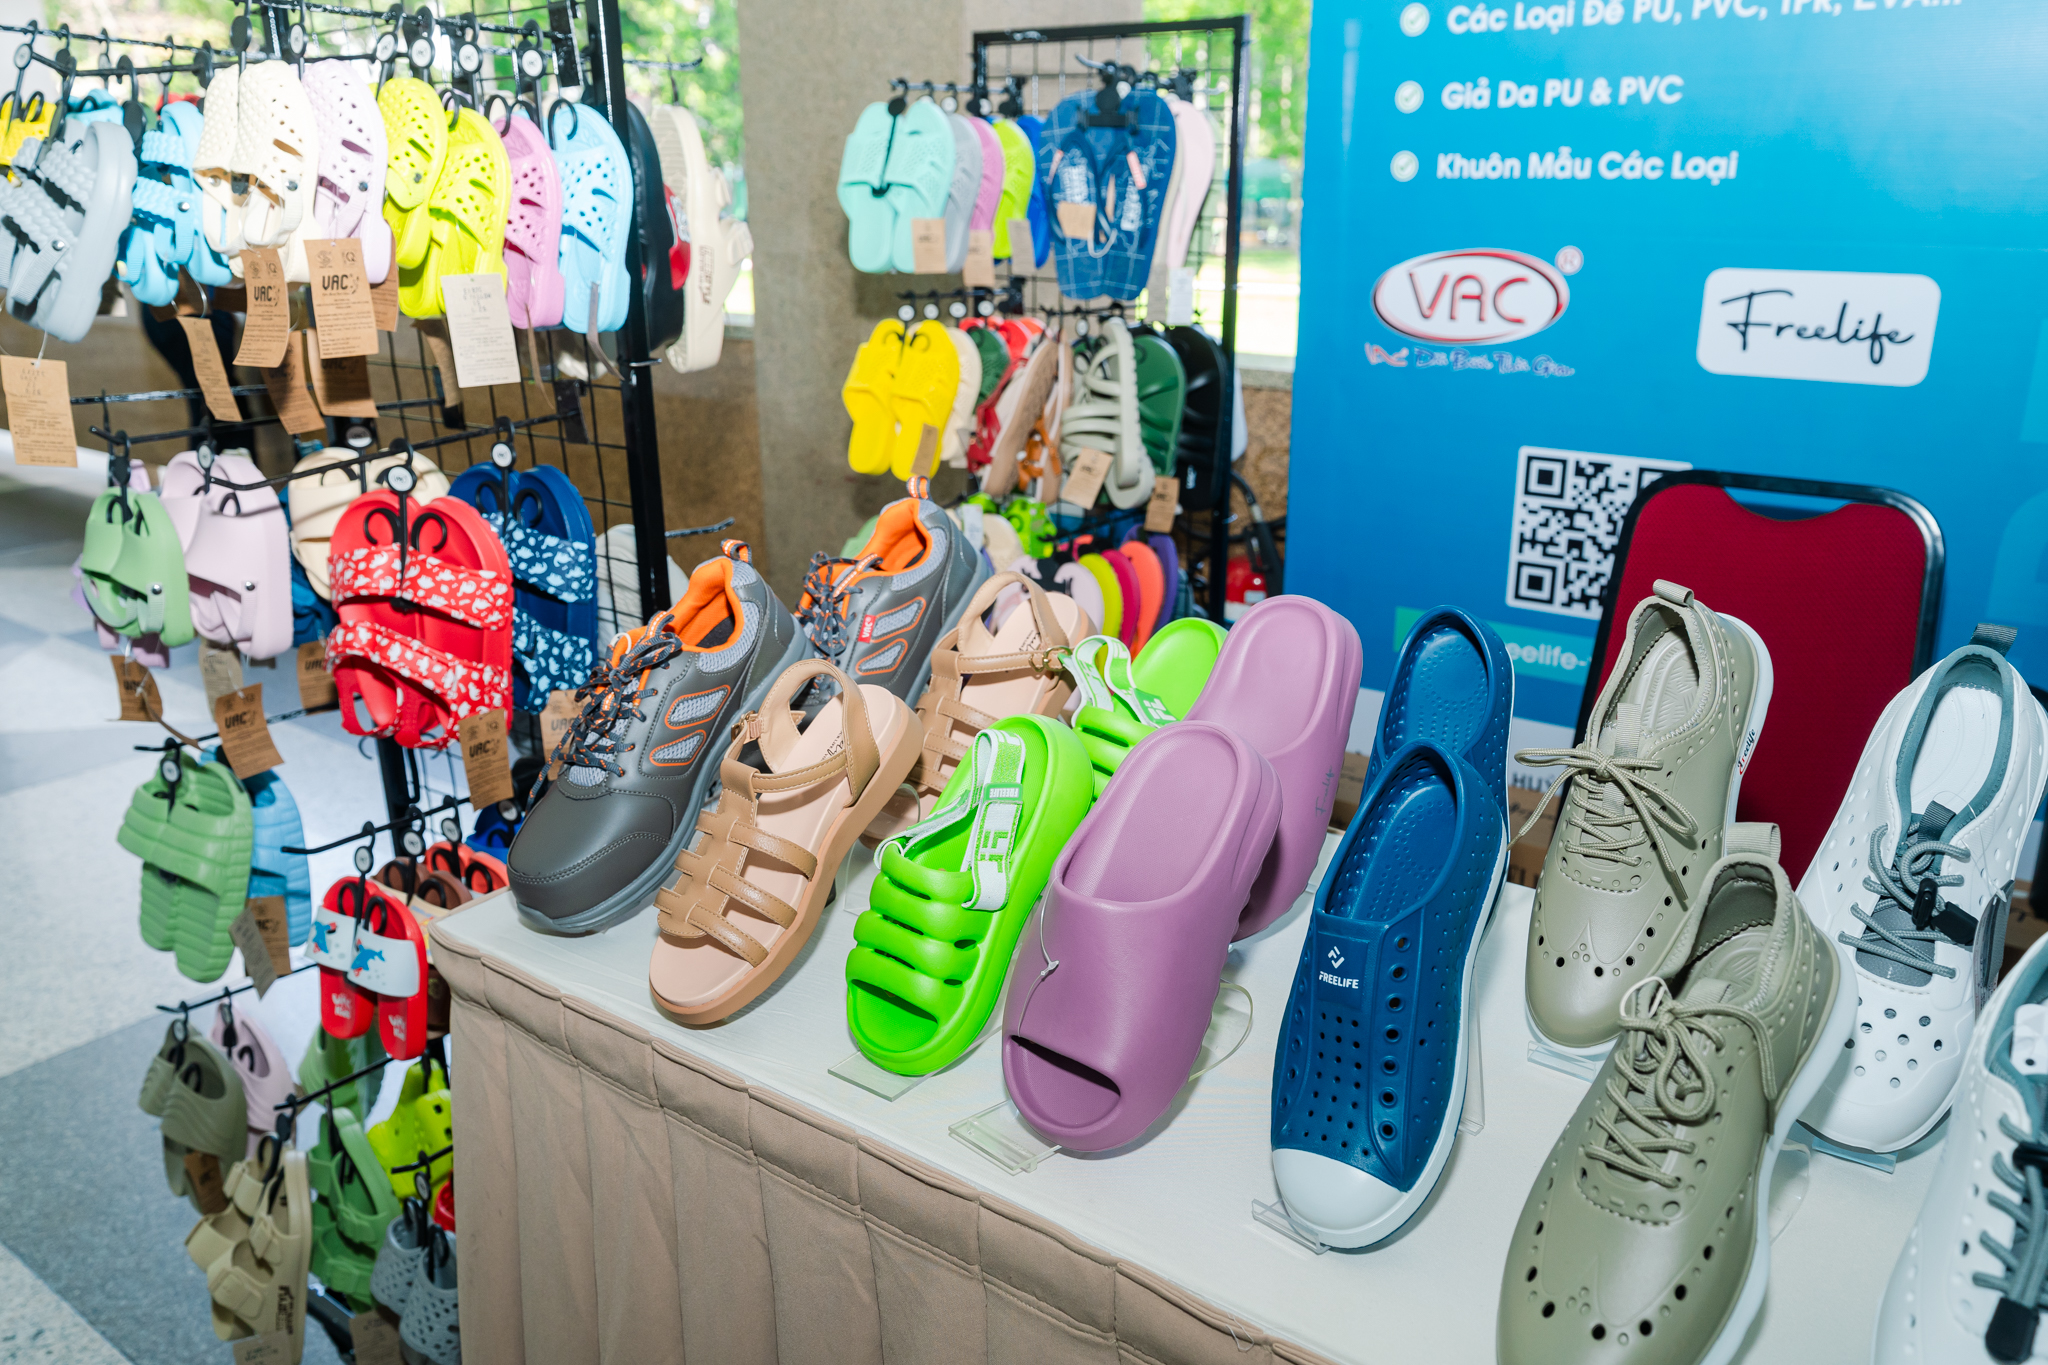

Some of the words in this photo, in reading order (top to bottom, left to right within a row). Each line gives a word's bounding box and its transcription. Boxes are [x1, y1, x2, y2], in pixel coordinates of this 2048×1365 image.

[1447, 2, 1509, 35] Các
[1513, 0, 1575, 35] Loại
[1441, 76, 1491, 110] Giả
[1497, 80, 1539, 109] Da
[1543, 77, 1584, 107] PU
[1589, 76, 1613, 107] &
[1618, 74, 1684, 105] PVC
[1436, 151, 1521, 180] Khuôn
[1598, 149, 1664, 180] Các
[1670, 150, 1739, 186] Loại
[1409, 272, 1529, 324] VAC
[1721, 289, 1914, 365] Freelife
[1319, 970, 1359, 989] FREELIFE
